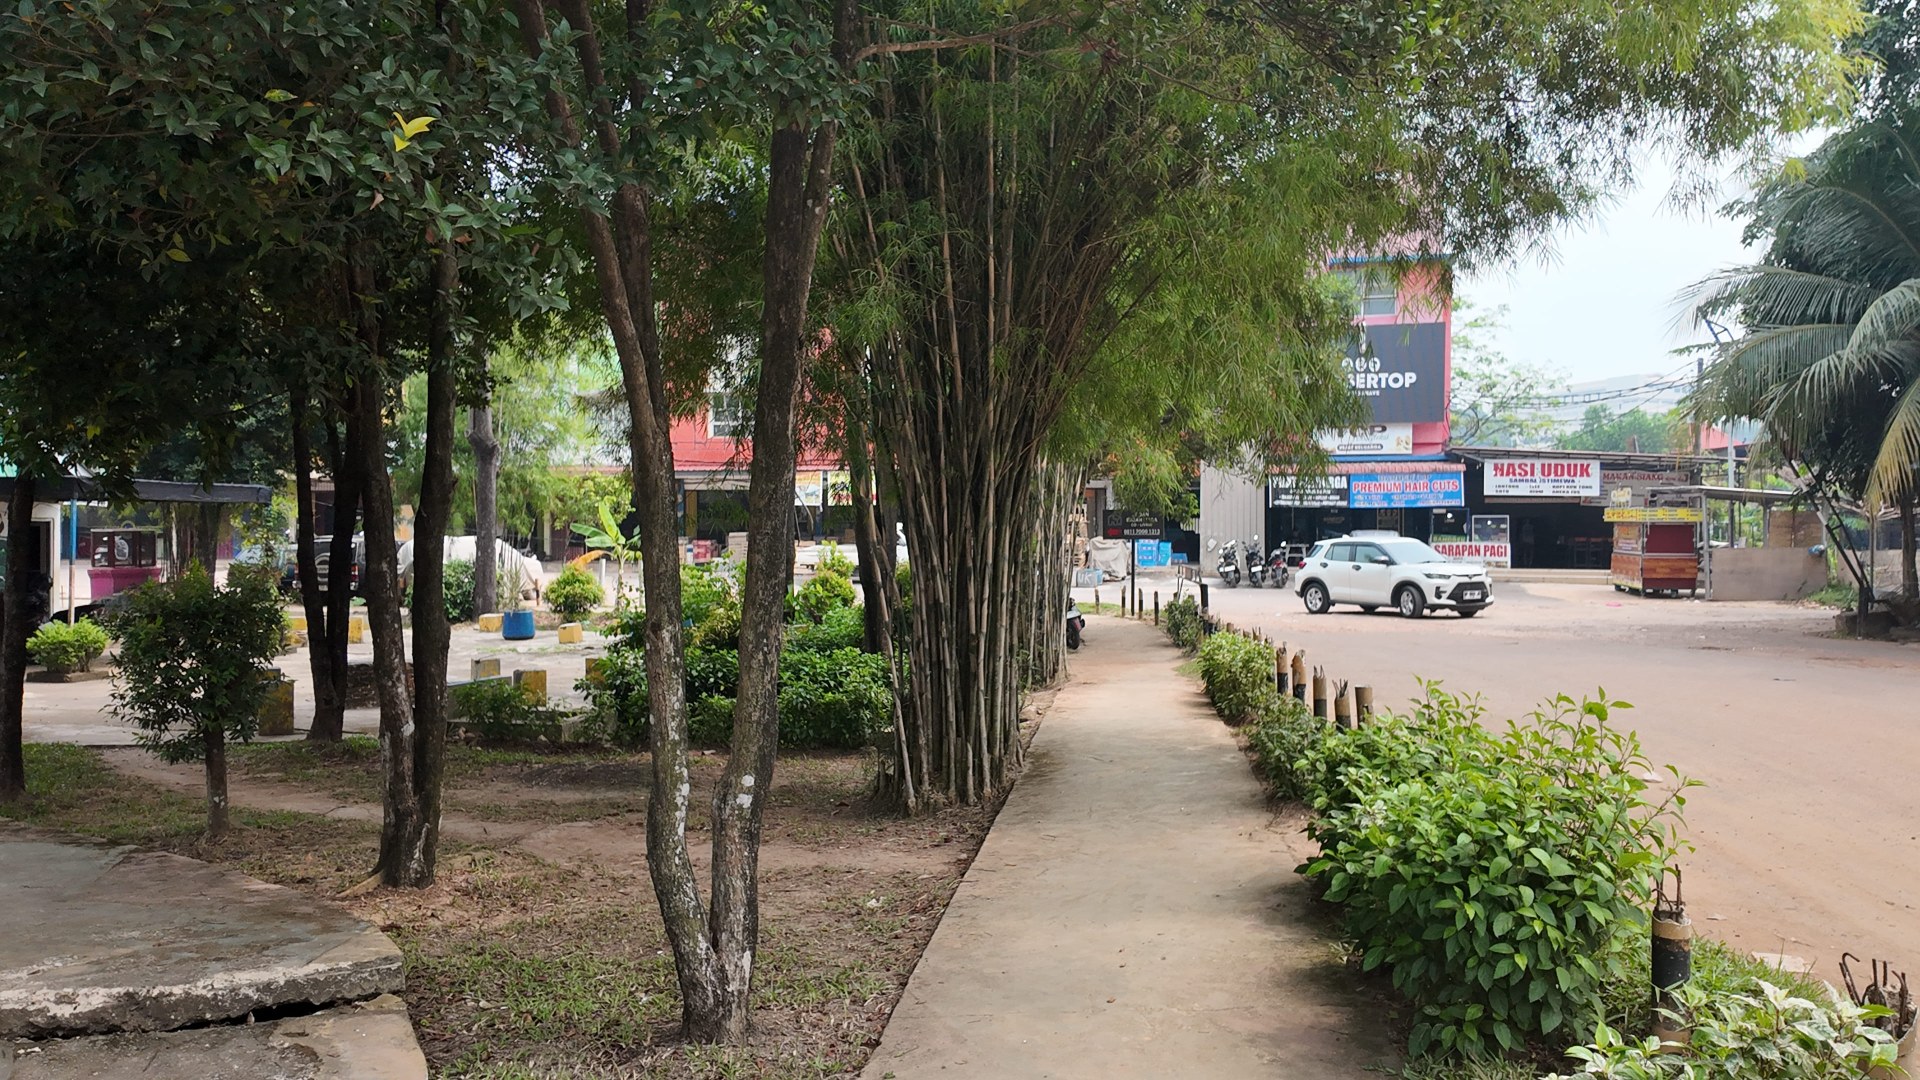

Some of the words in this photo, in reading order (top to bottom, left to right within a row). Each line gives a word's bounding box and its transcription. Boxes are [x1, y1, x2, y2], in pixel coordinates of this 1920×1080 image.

[1493, 462, 1536, 477] NASI
[1540, 463, 1592, 478] UDUK
[1353, 482, 1402, 494] PREMIUM
[1403, 481, 1430, 493] HAIR
[1431, 480, 1459, 492] CUTS
[1434, 544, 1481, 557] SARAPAN
[1483, 544, 1508, 558] PAGI
